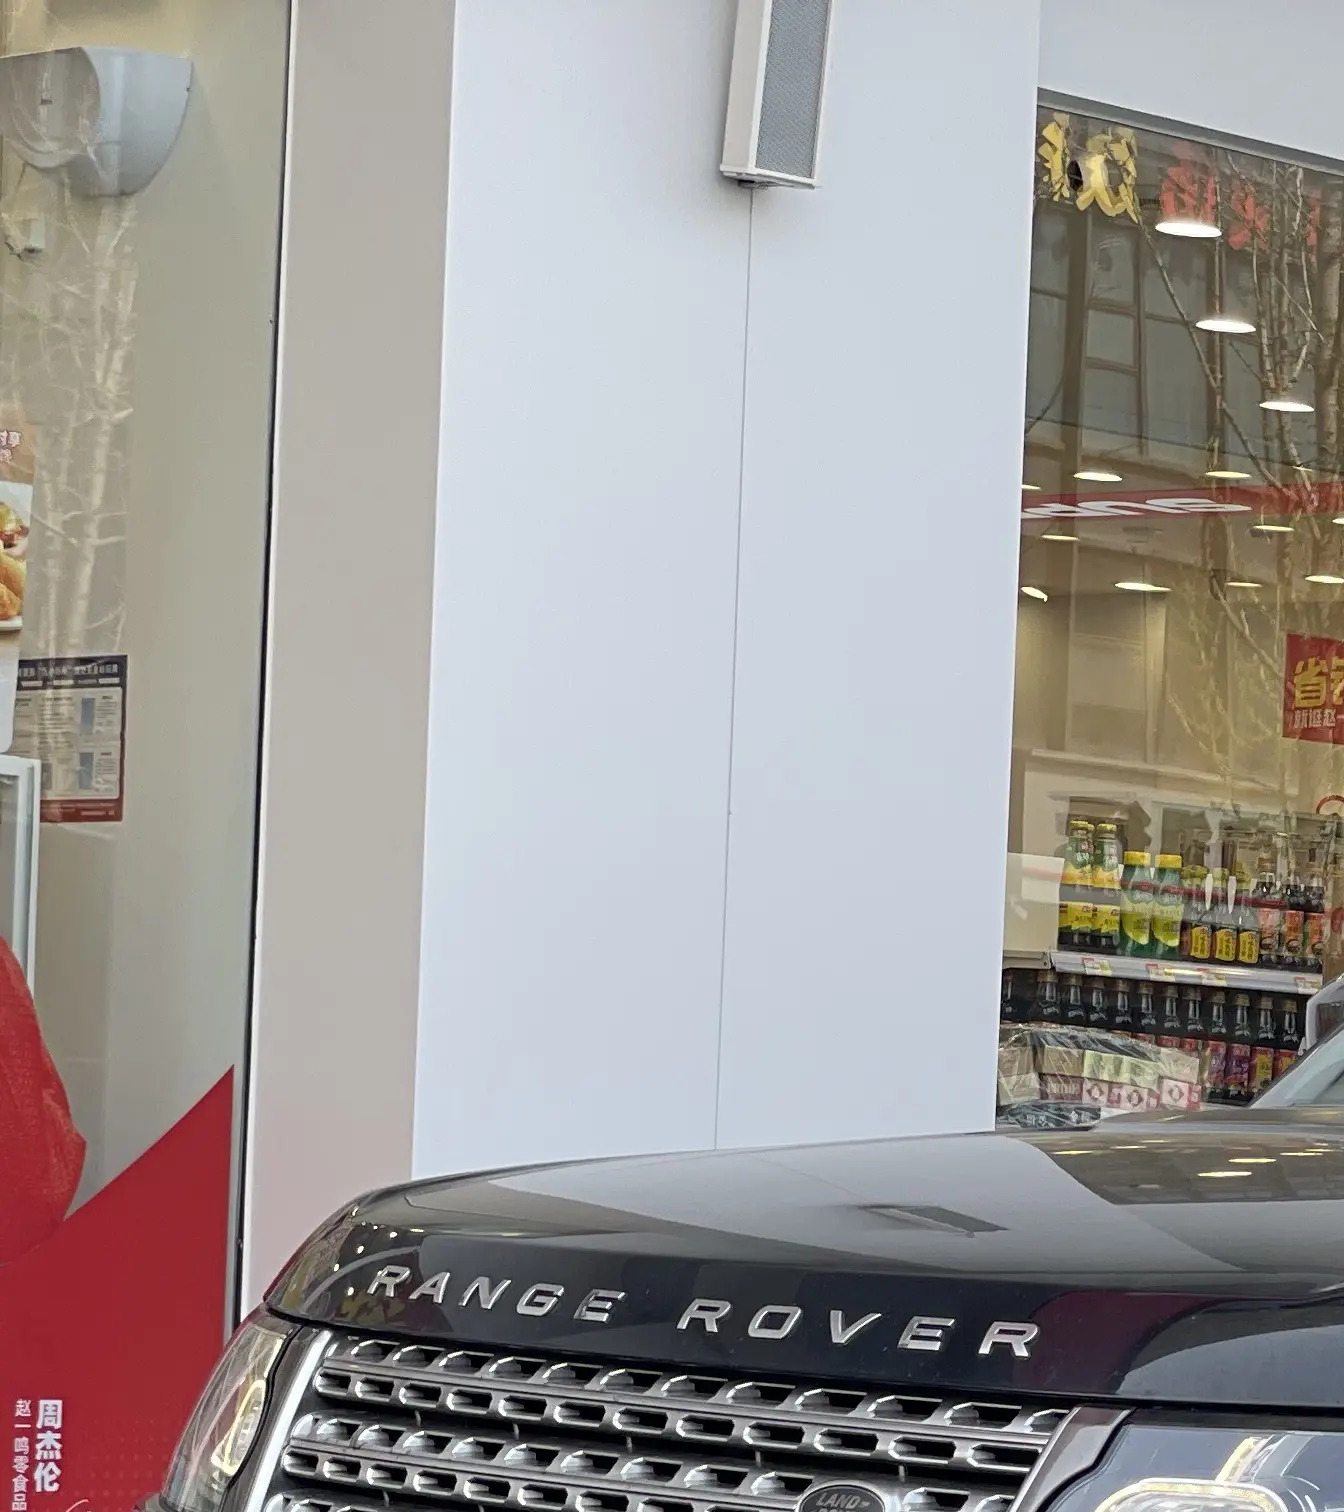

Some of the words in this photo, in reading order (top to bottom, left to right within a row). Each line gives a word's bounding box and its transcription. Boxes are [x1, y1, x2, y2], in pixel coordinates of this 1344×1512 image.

[367, 1264, 627, 1323] RANGE
[676, 1298, 1044, 1359] ROVER
[33, 1399, 63, 1492] 周杰伦
